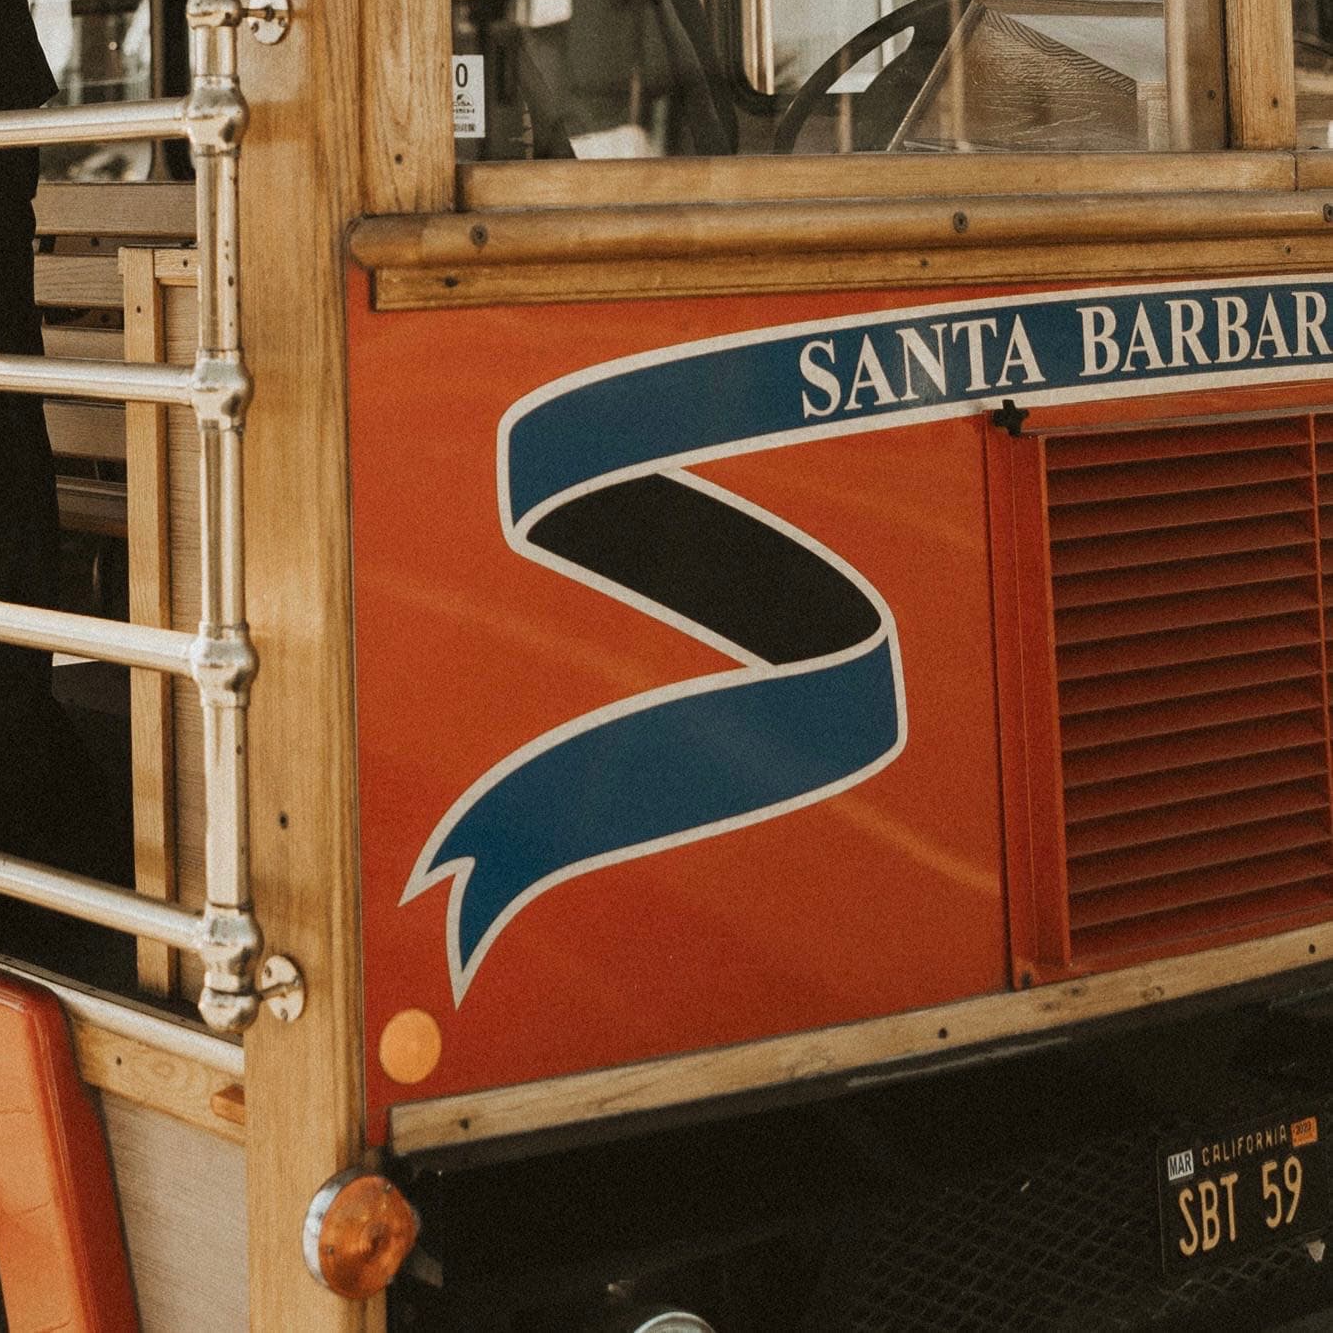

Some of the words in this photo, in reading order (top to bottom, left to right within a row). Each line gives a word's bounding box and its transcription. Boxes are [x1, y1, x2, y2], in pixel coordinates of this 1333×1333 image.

[800, 313, 1046, 419] SANTA
[1076, 290, 1333, 378] BARBAR
[1169, 1153, 1192, 1177] MAR
[1202, 1125, 1287, 1166] CALIFORNIA
[1179, 1173, 1238, 1257] SBT
[1262, 1156, 1302, 1229] 59
